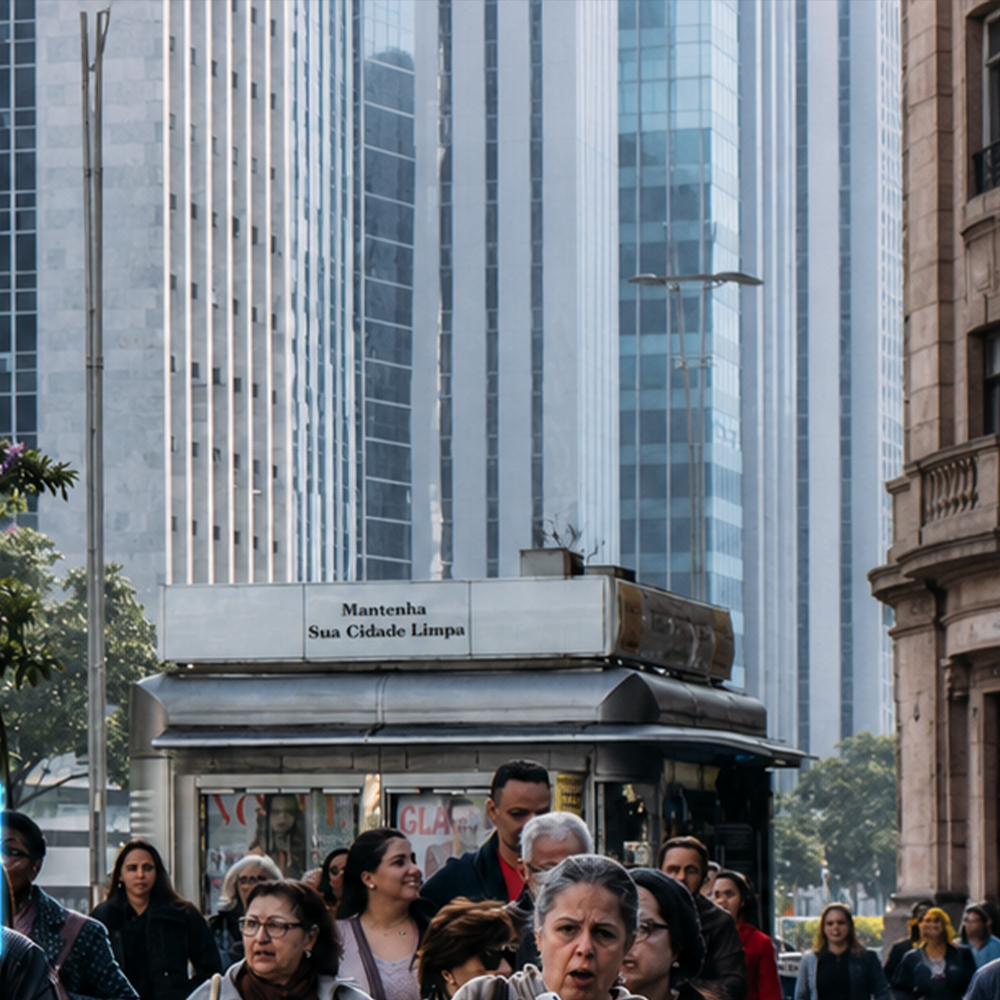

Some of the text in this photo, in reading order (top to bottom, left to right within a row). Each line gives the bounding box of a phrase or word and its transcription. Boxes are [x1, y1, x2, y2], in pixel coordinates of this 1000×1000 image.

[341, 602, 427, 617] Mantenha
[308, 623, 465, 640] Sua Cidade Limpa
